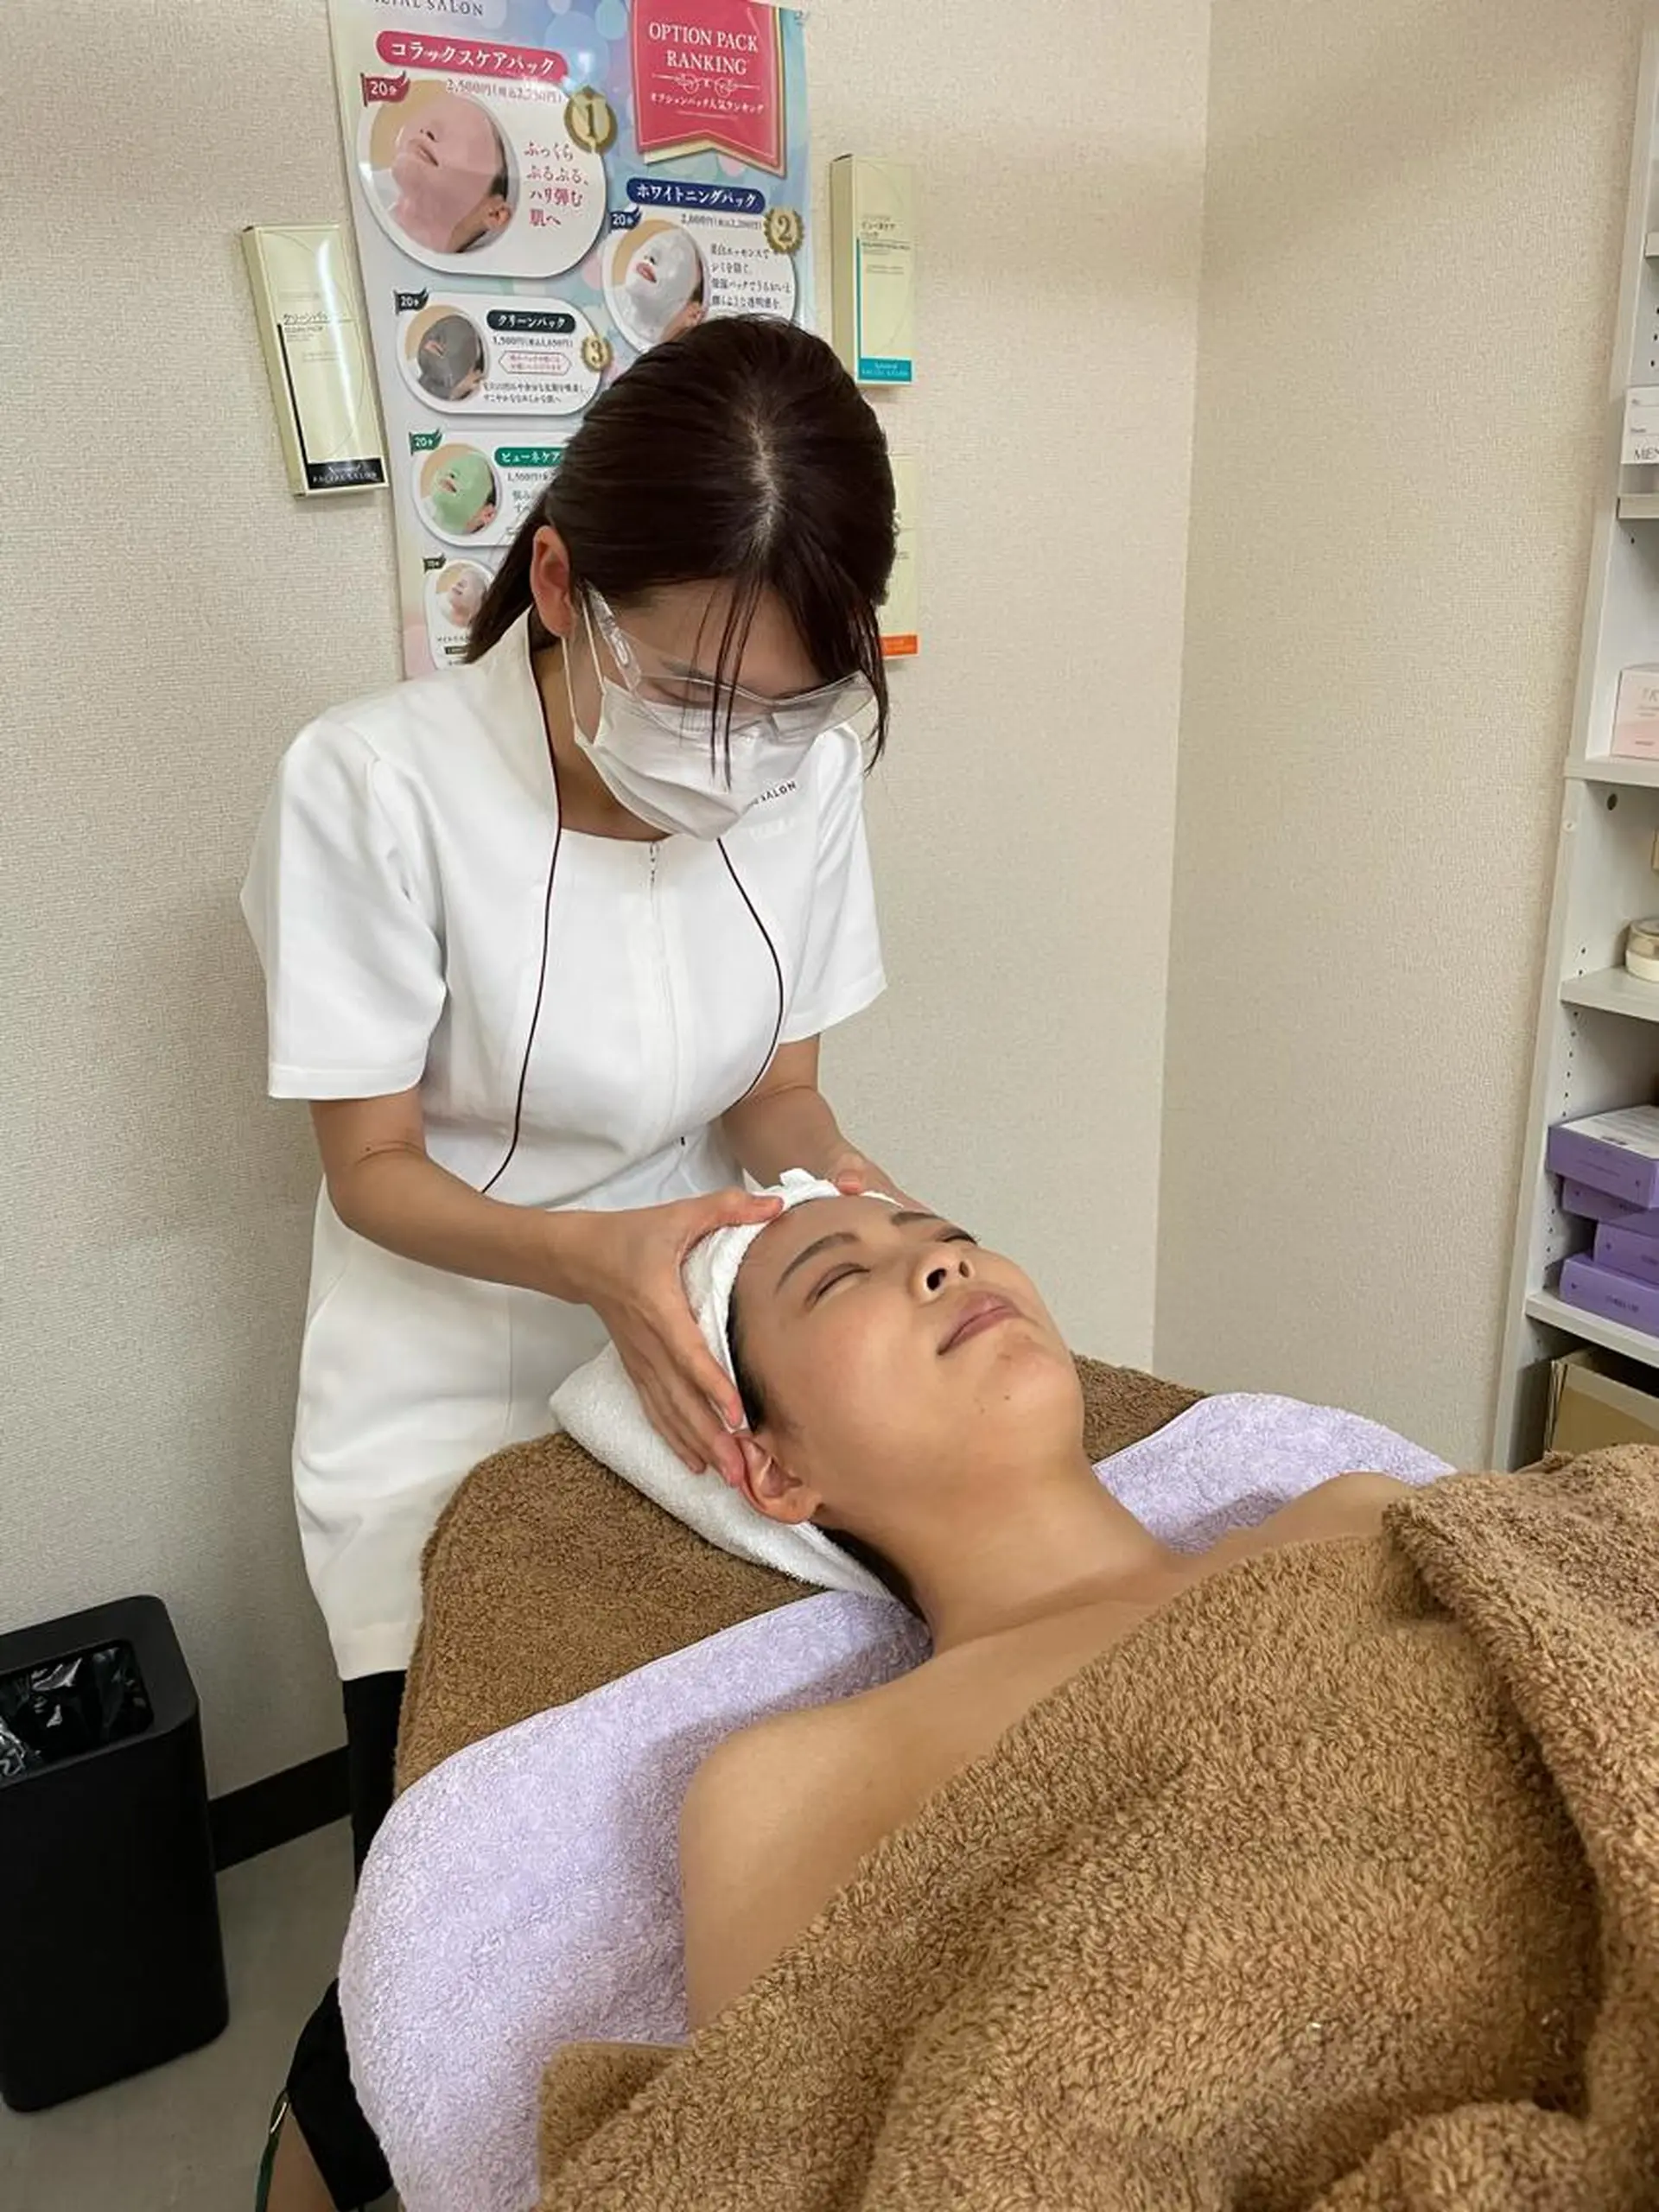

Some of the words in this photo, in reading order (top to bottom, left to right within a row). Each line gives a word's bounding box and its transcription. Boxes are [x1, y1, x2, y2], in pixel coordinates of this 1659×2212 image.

[428, 0, 483, 16] SALON
[649, 22, 712, 46] OPTION
[716, 31, 759, 53] PACK
[666, 50, 747, 75] RANKING
[585, 102, 597, 140] 1
[777, 215, 792, 242] 2
